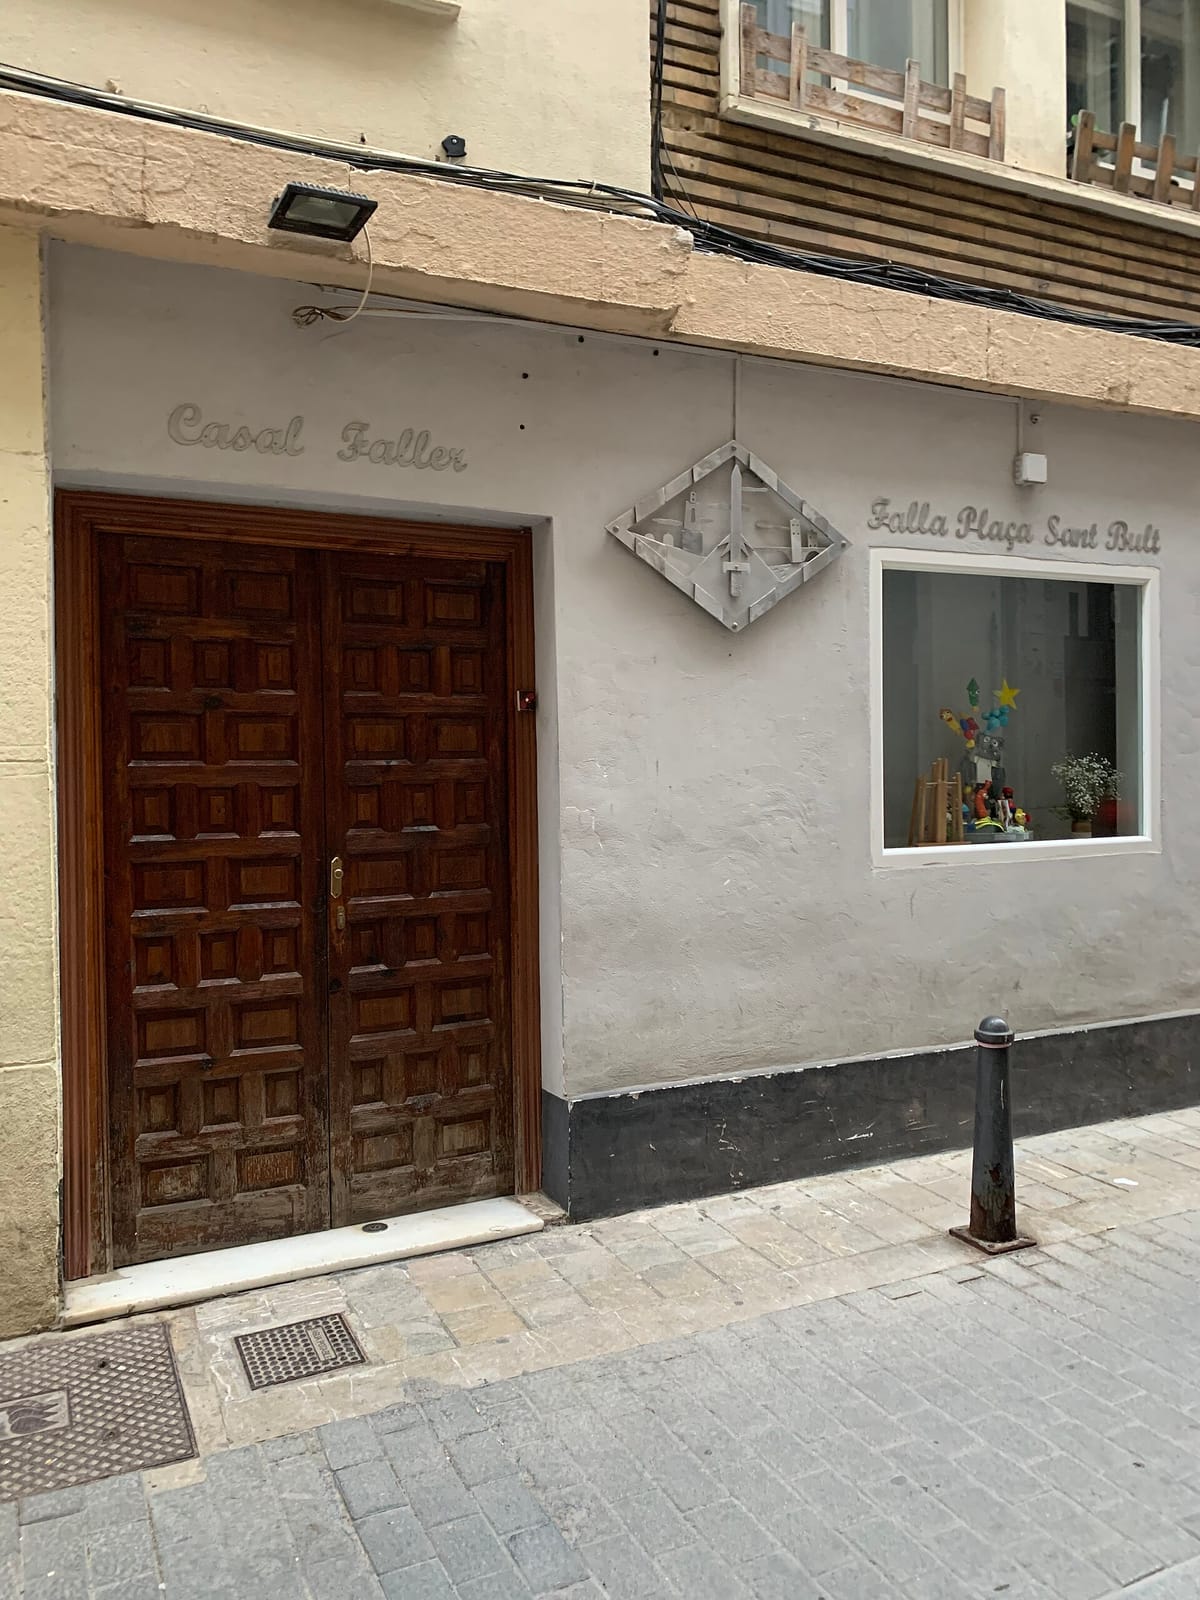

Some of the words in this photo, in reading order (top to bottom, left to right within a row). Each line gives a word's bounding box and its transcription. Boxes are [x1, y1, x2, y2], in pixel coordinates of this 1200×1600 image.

[167, 402, 304, 457] Casal
[336, 420, 468, 473] Faller
[867, 498, 949, 538] Falla
[955, 506, 1033, 551] Plaça
[1044, 514, 1098, 550] Sant
[1105, 519, 1161, 555] Bult
